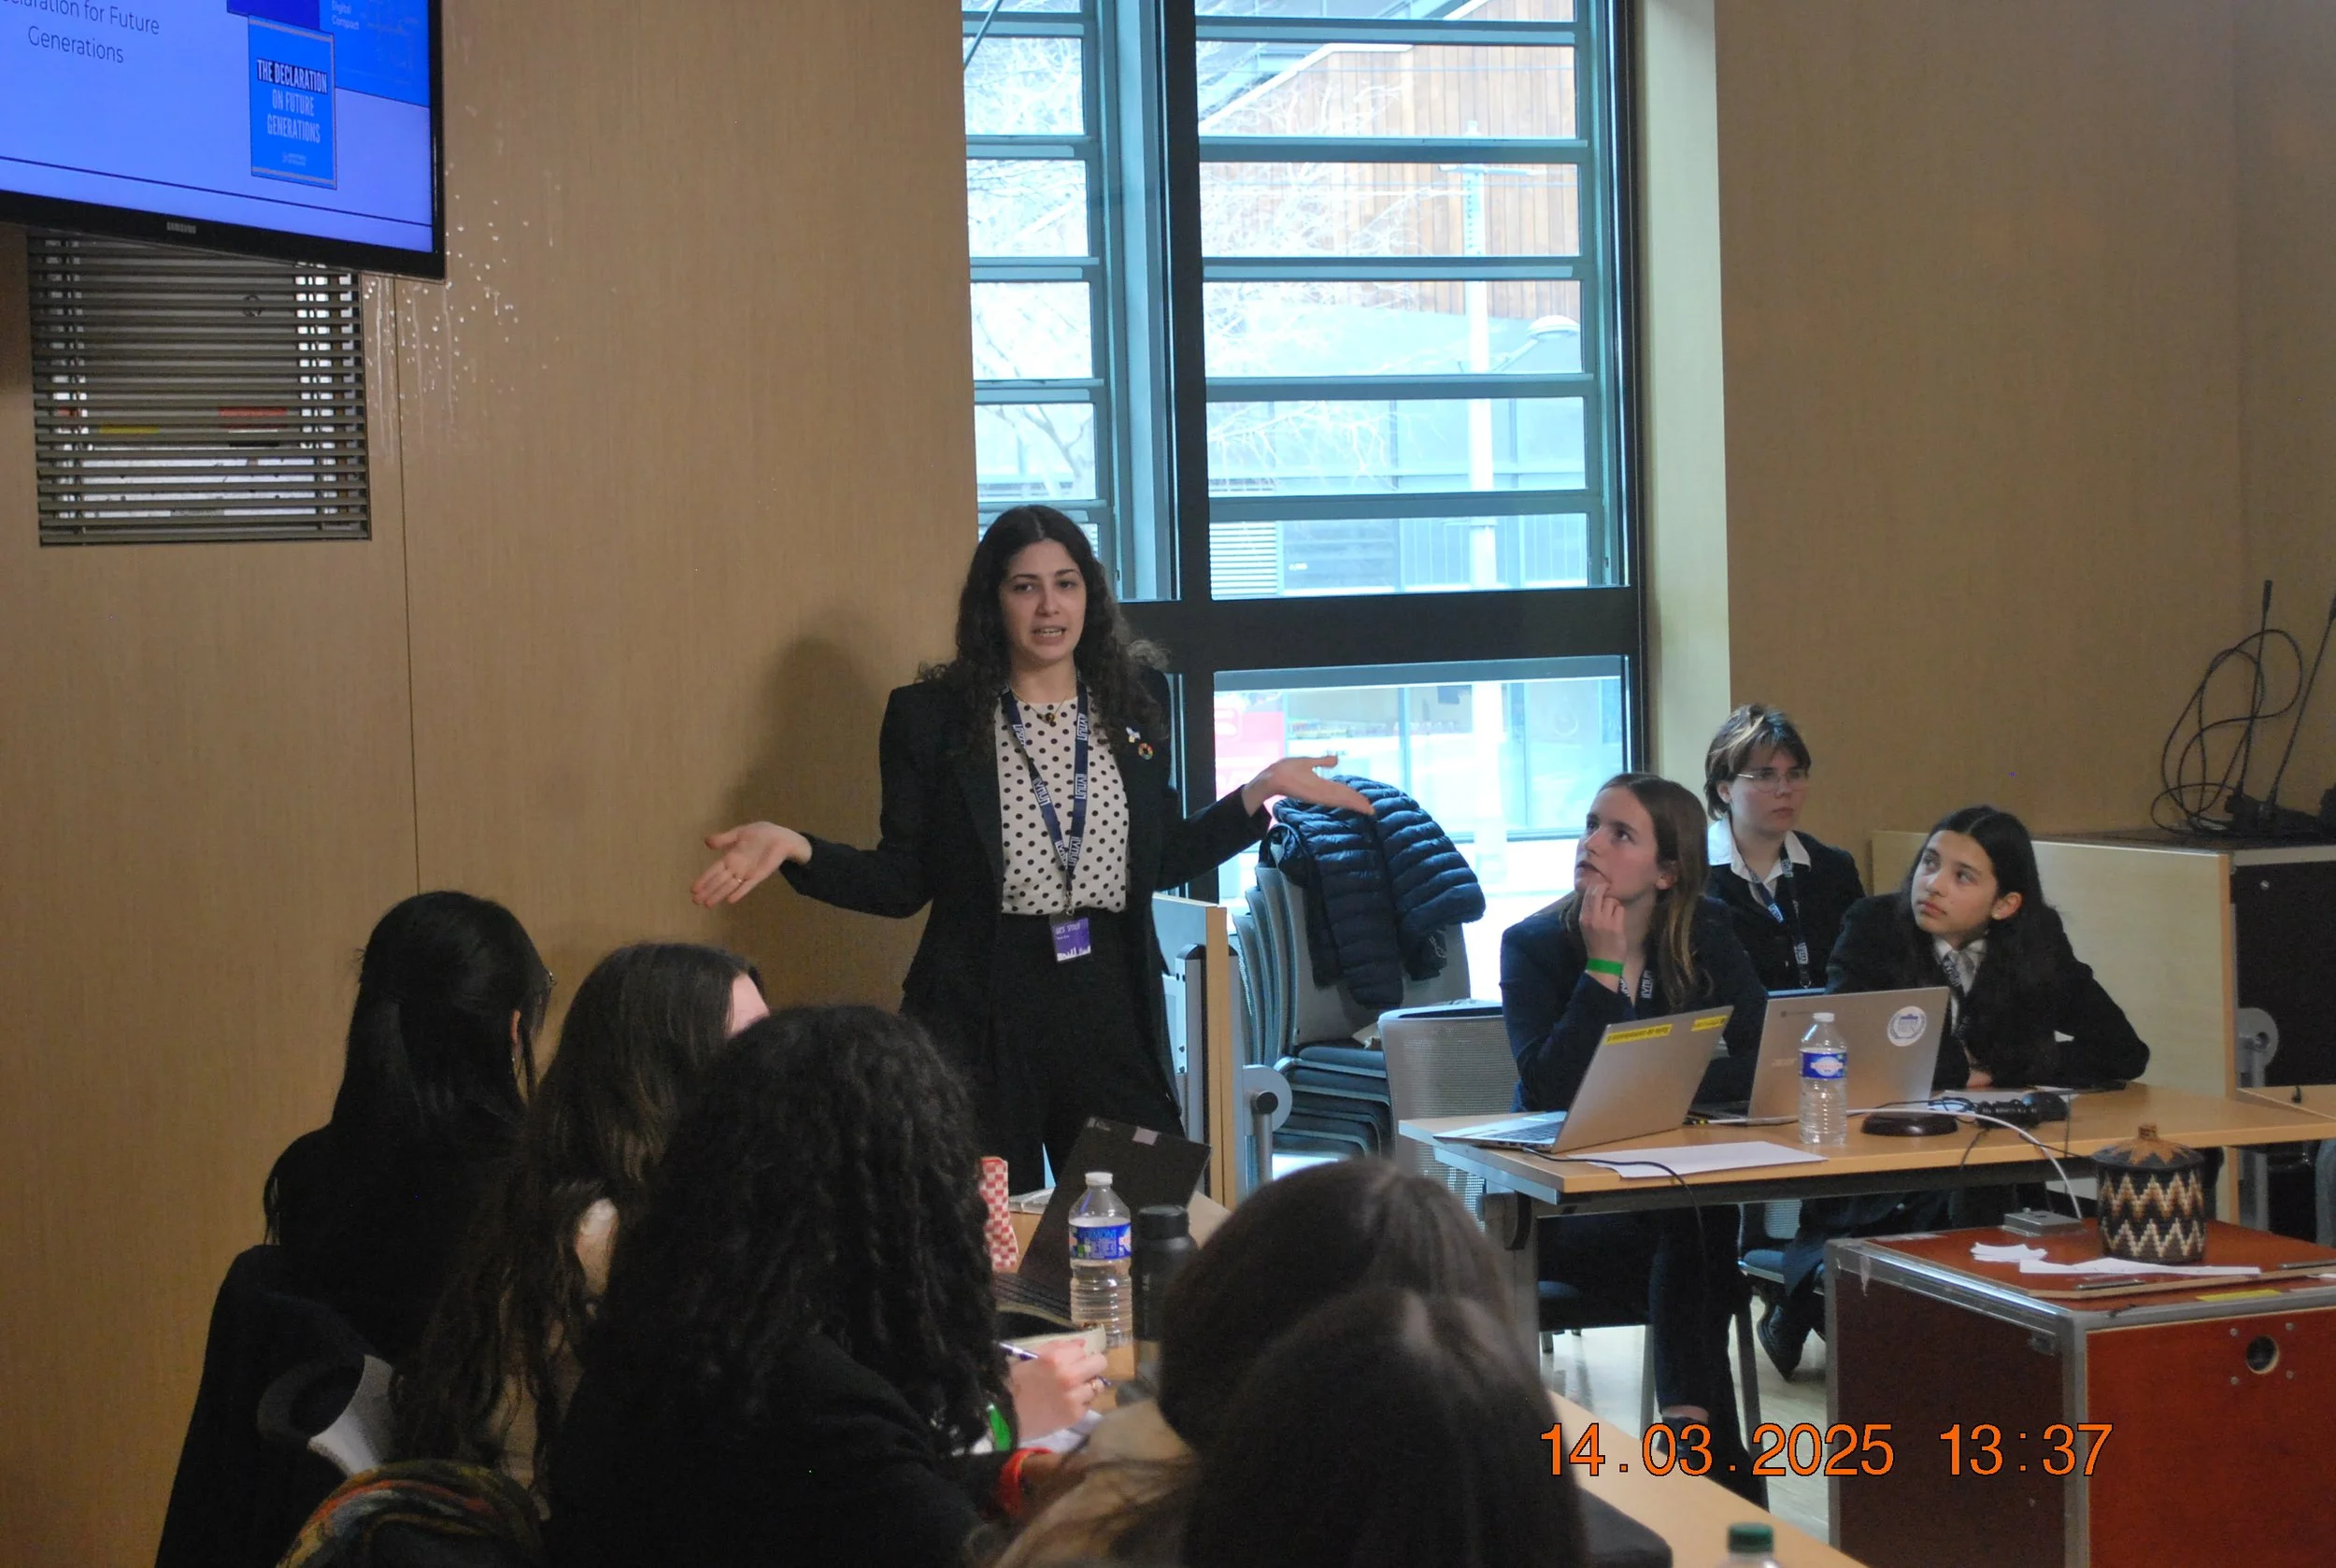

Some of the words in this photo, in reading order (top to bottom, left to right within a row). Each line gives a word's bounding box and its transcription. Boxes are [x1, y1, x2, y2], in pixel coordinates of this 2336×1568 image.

[3, 0, 80, 18] ration
[83, 0, 105, 23] for
[109, 6, 161, 36] Future
[28, 25, 125, 64] Generations
[257, 59, 274, 82] THE
[274, 63, 328, 93] DECLARATION
[272, 88, 284, 111] ON
[285, 92, 315, 117] FUTURE
[267, 113, 320, 144] GENERATIONS
